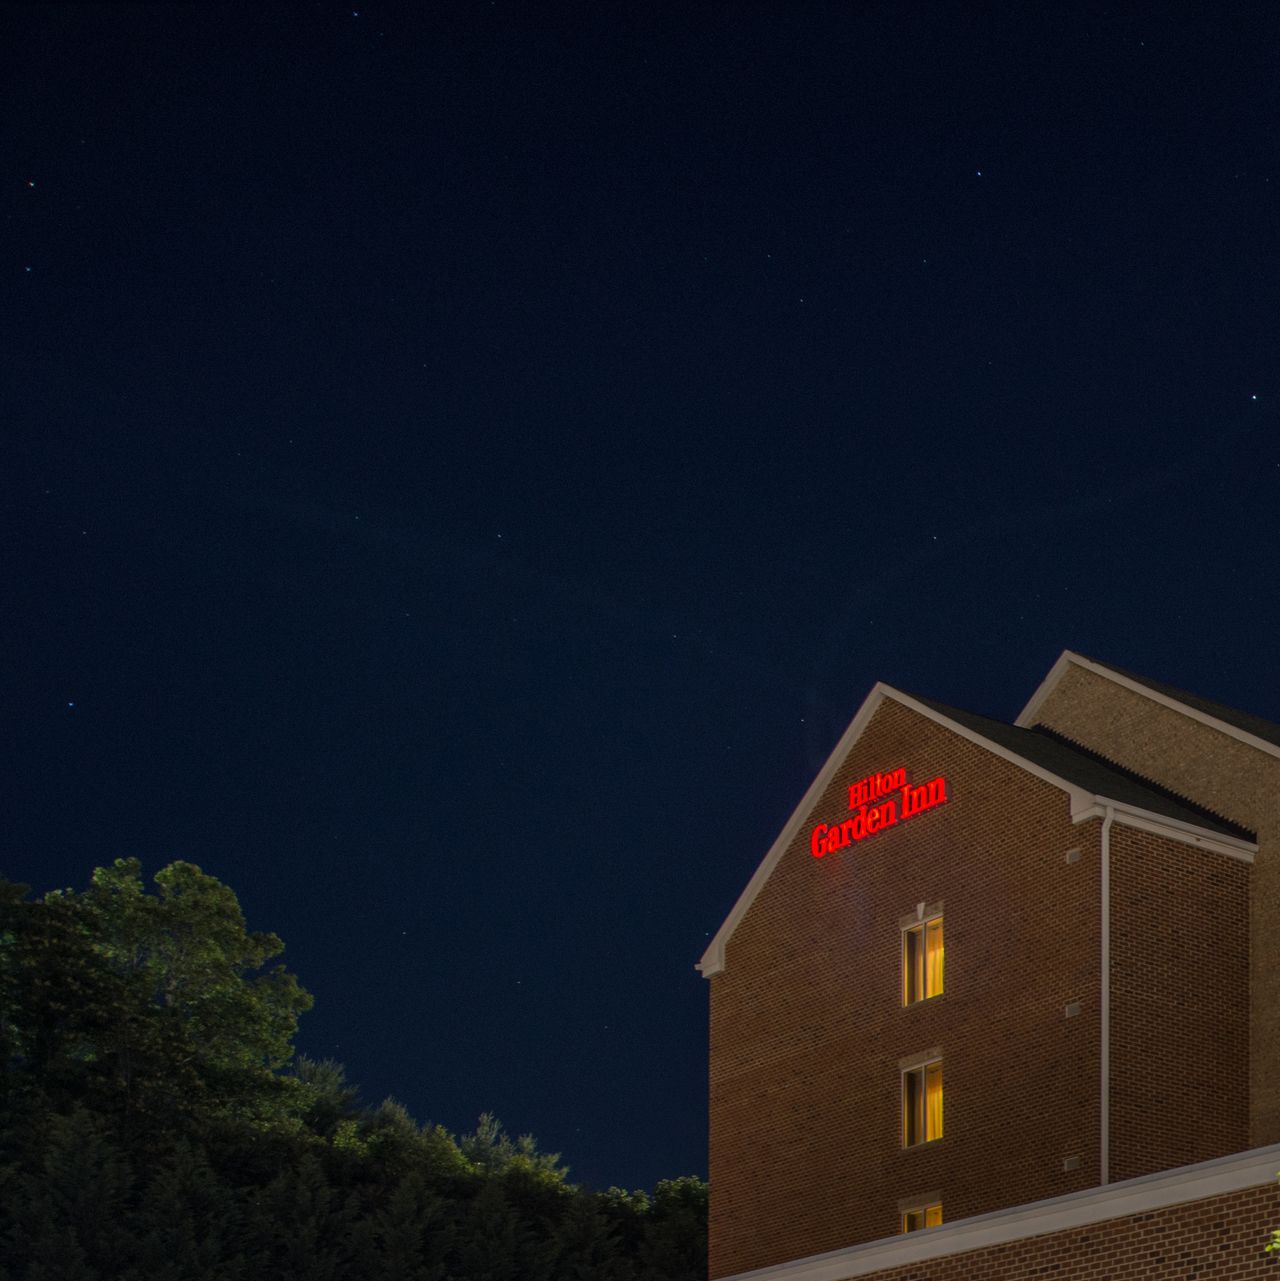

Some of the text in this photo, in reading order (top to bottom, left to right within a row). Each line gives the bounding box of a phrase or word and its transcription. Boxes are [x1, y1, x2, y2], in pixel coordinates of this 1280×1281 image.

[811, 777, 947, 858] Garden Inn
[848, 768, 906, 810] Hilton
